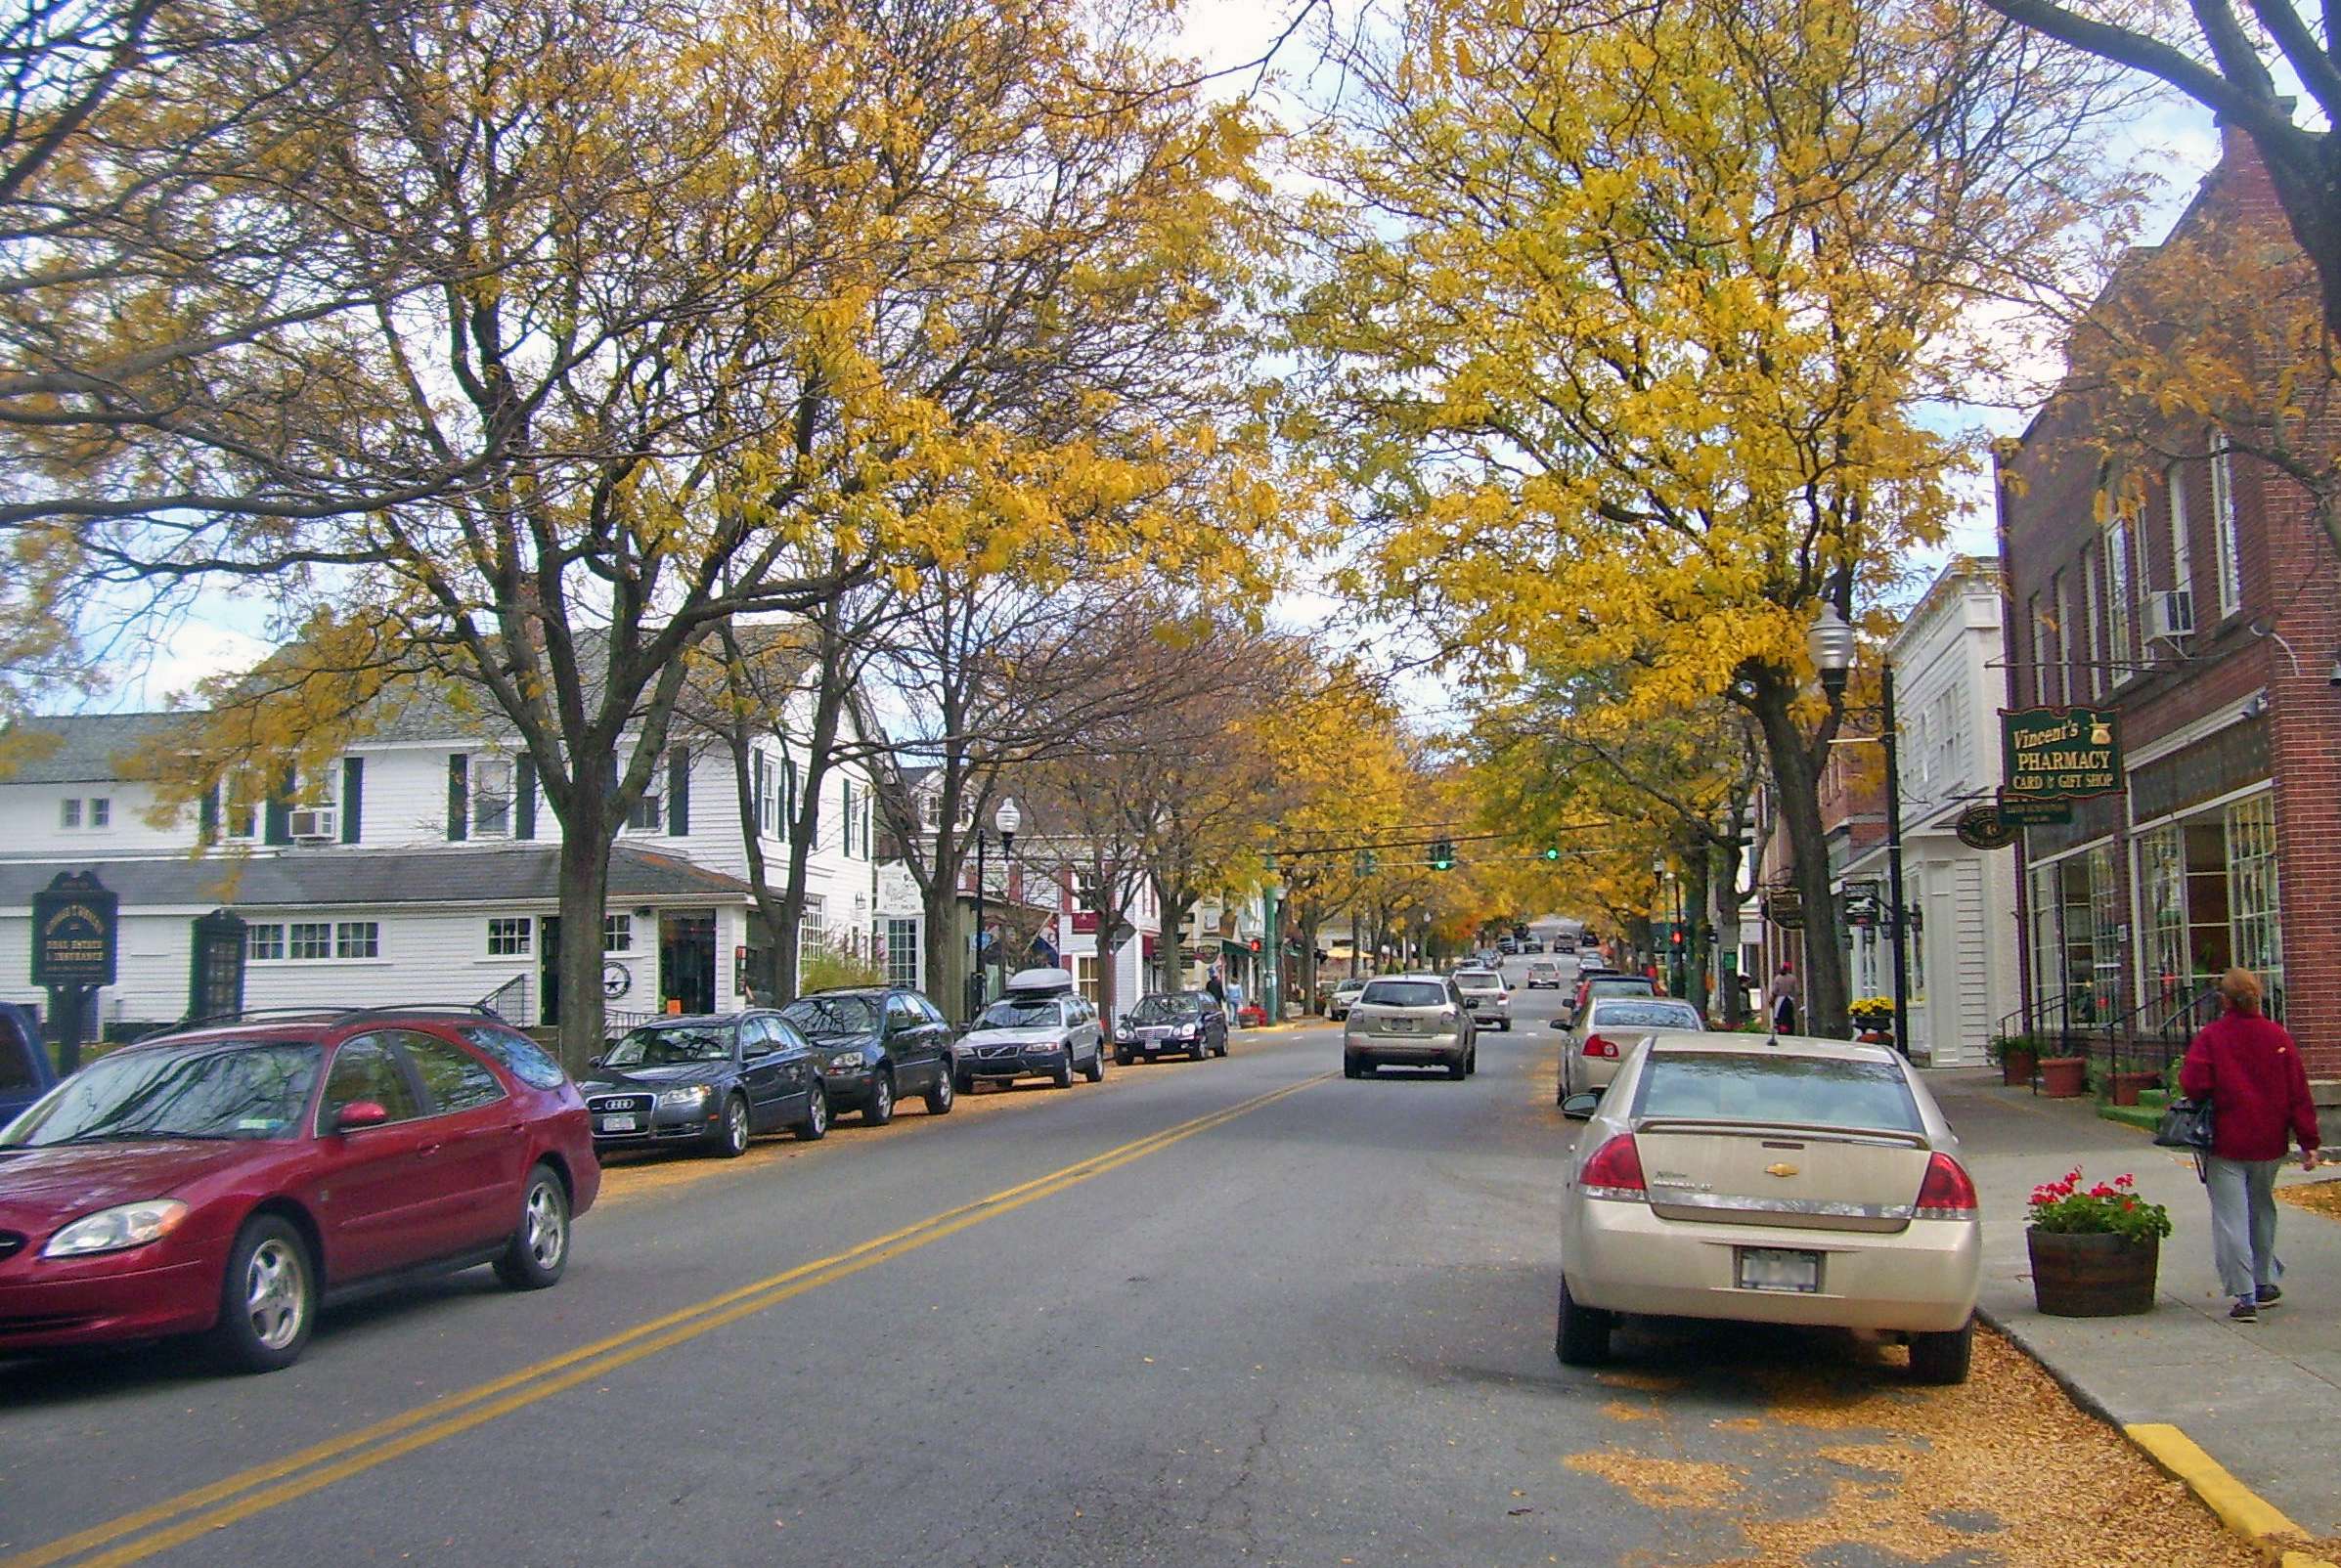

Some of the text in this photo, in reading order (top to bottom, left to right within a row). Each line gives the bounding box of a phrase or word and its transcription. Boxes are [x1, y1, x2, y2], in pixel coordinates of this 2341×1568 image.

[2012, 719, 2080, 750] Vincent's
[2017, 751, 2111, 771] PHARMACY
[2012, 775, 2043, 790] CARD
[2058, 774, 2083, 788] GIFT
[2085, 773, 2113, 787] SHOP
